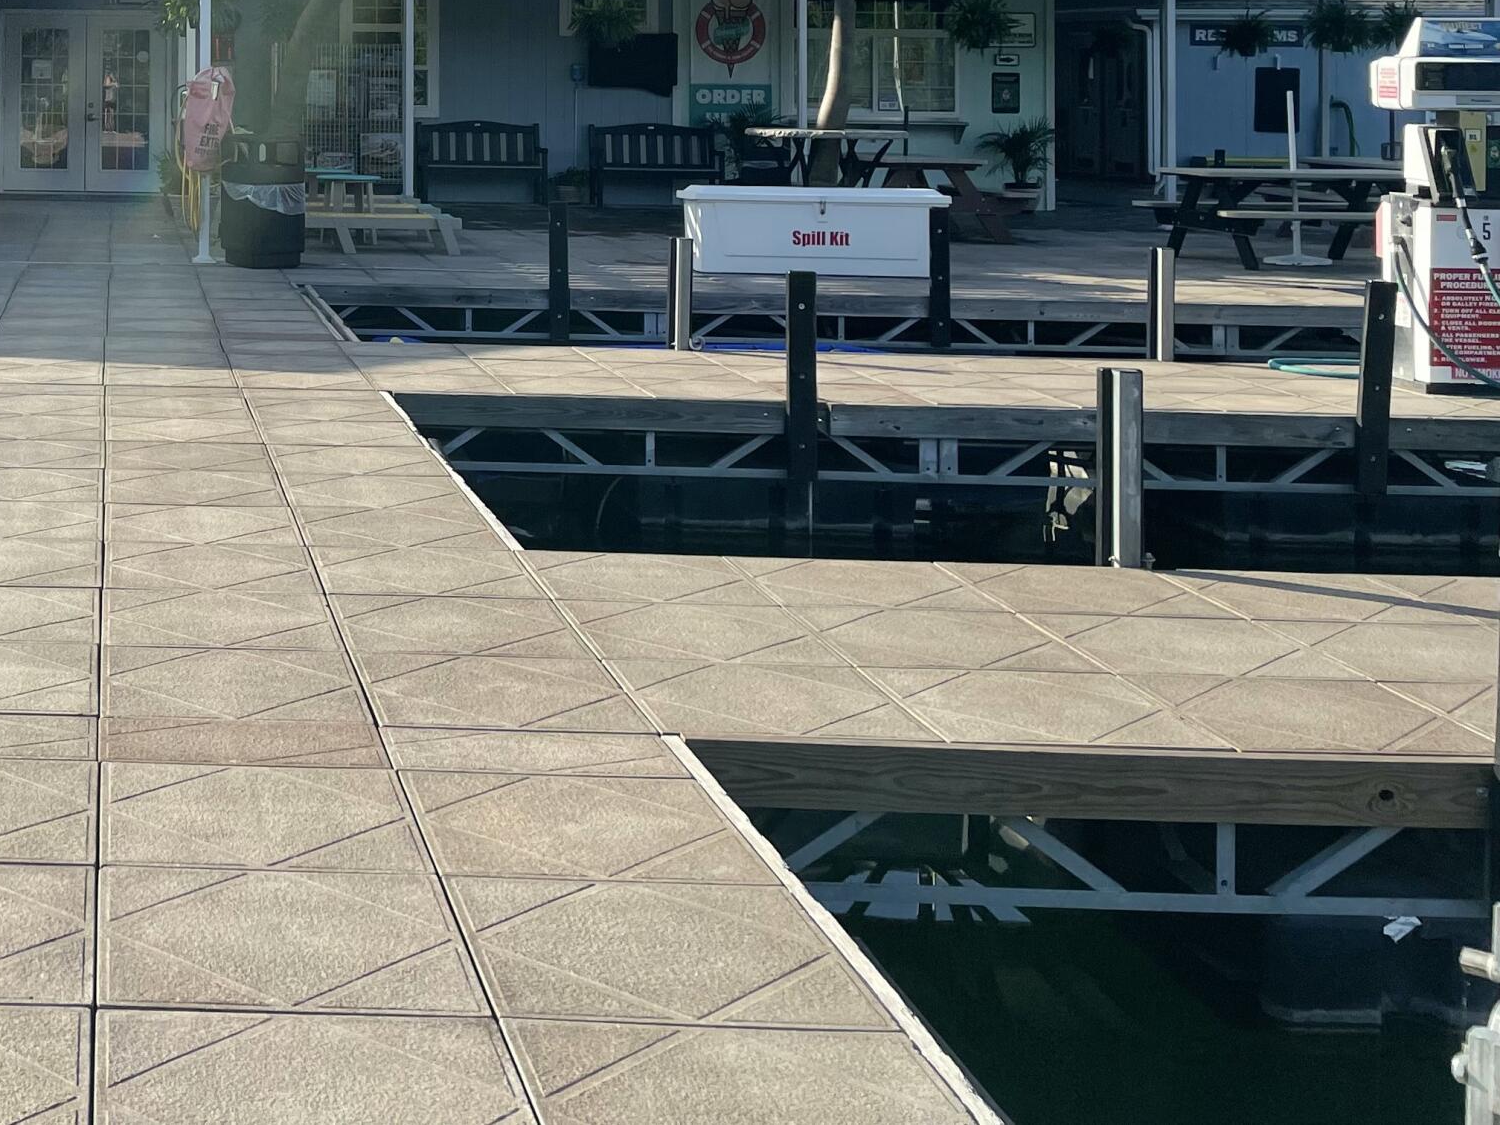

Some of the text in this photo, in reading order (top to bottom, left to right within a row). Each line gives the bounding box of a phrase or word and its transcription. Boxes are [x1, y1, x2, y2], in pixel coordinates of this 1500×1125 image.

[695, 88, 766, 105] ORDER
[792, 230, 850, 247] Spill Kit
[1483, 222, 1492, 241] 5
[1433, 273, 1471, 281] PROPER
